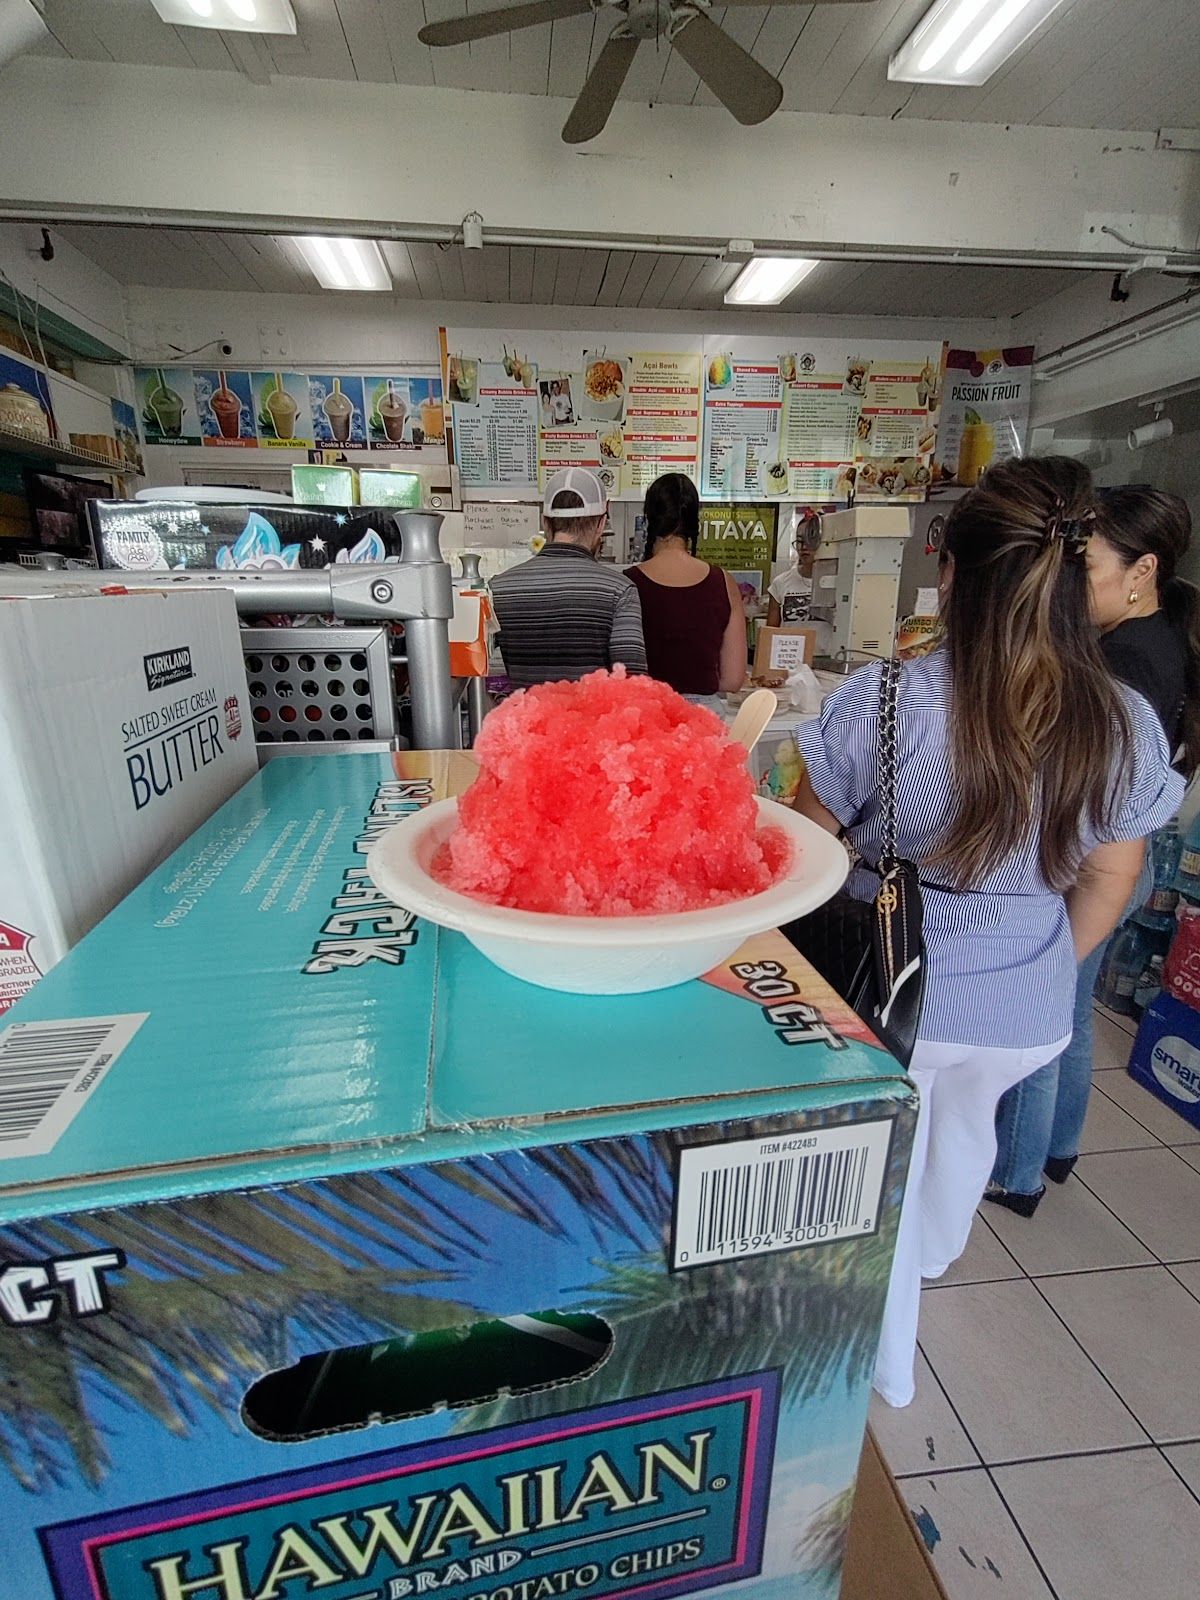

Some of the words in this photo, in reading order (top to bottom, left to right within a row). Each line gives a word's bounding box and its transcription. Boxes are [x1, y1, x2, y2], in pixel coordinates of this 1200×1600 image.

[952, 386, 989, 402] PASSION
[992, 384, 1021, 400] FRUIT
[216, 439, 245, 447] Strawberry
[467, 505, 489, 513] Please
[115, 531, 150, 544] FAMILY
[701, 520, 768, 540] ITAYA
[146, 650, 190, 676] KIRKLAND
[151, 668, 191, 689] Signature
[121, 711, 160, 743] SALTED
[163, 699, 189, 726] SWEET
[191, 688, 218, 713] CREAM
[126, 714, 225, 811] BUTTER
[730, 961, 800, 999] 30
[762, 1001, 849, 1051] CT
[1153, 1047, 1200, 1091] smar
[760, 1142, 781, 1155] ITEM
[782, 1137, 818, 1153] #422483
[680, 1252, 689, 1262] 0
[717, 1234, 773, 1256] 11594
[783, 1221, 840, 1245] 30001
[863, 1218, 871, 1229] 8
[0, 1251, 124, 1325] CT
[150, 1431, 711, 1600] HAWAIIAN
[388, 1550, 522, 1599] BRAND
[610, 1539, 701, 1579] CHIPS
